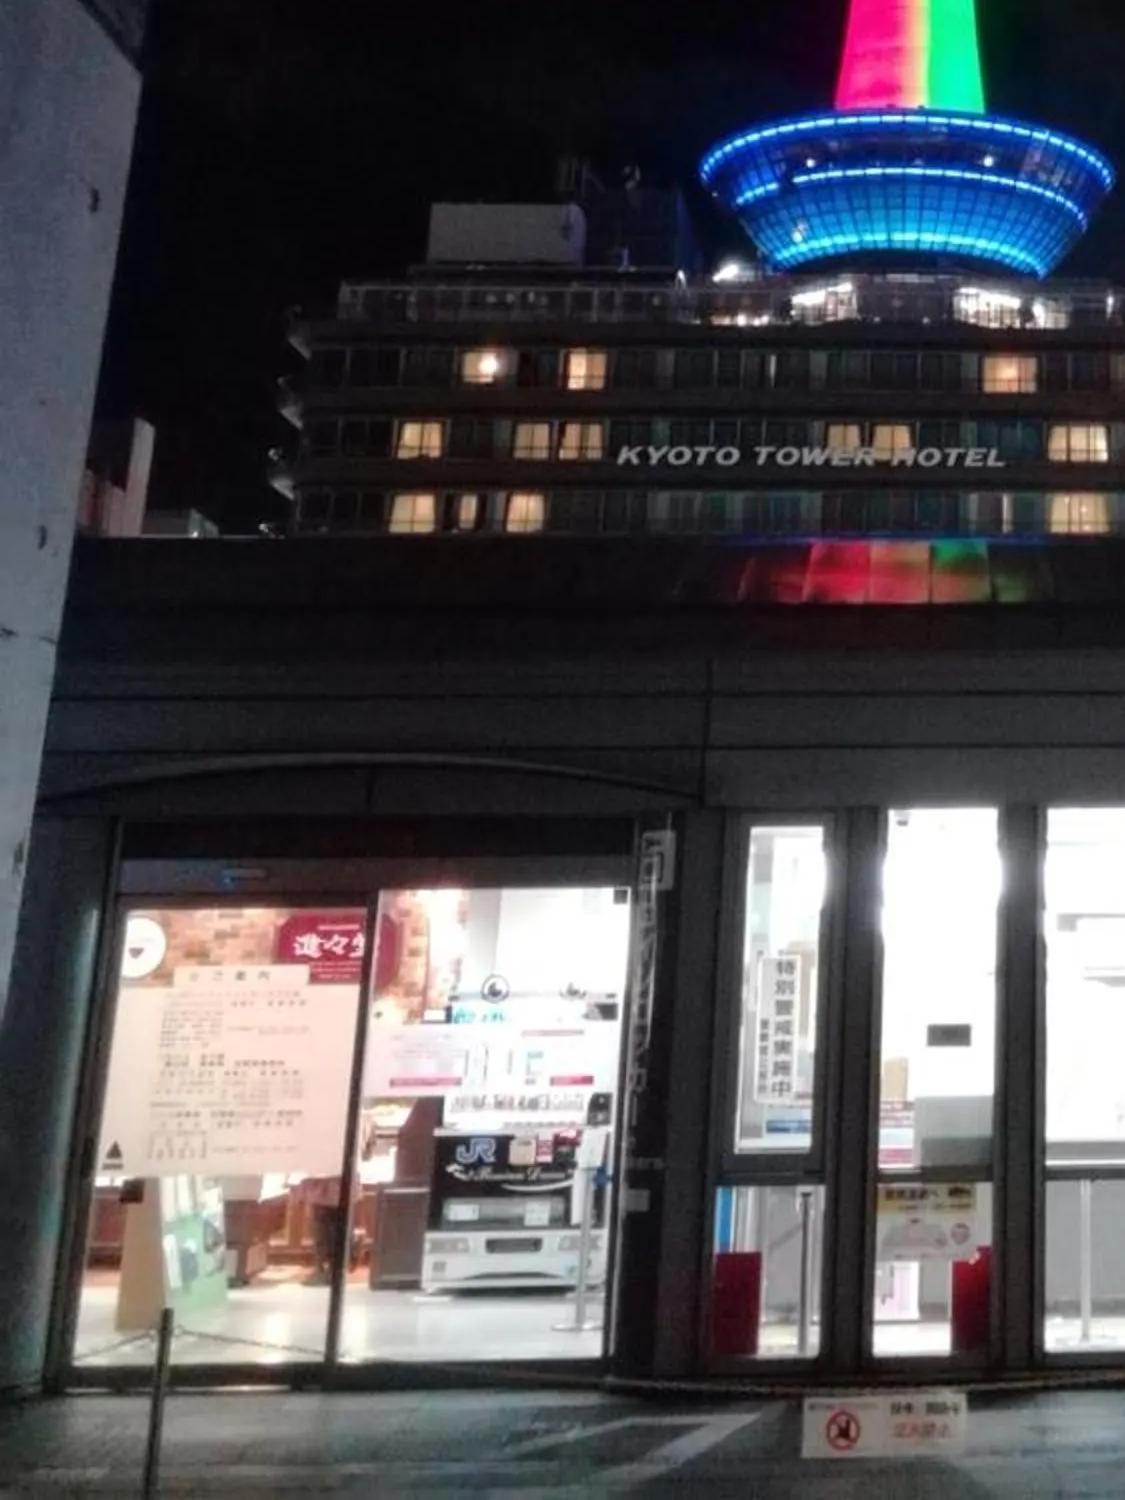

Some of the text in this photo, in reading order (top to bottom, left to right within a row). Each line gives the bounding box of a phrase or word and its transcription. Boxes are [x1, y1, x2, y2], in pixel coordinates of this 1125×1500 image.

[616, 445, 1007, 468] KYOTO TOWER HOTEL
